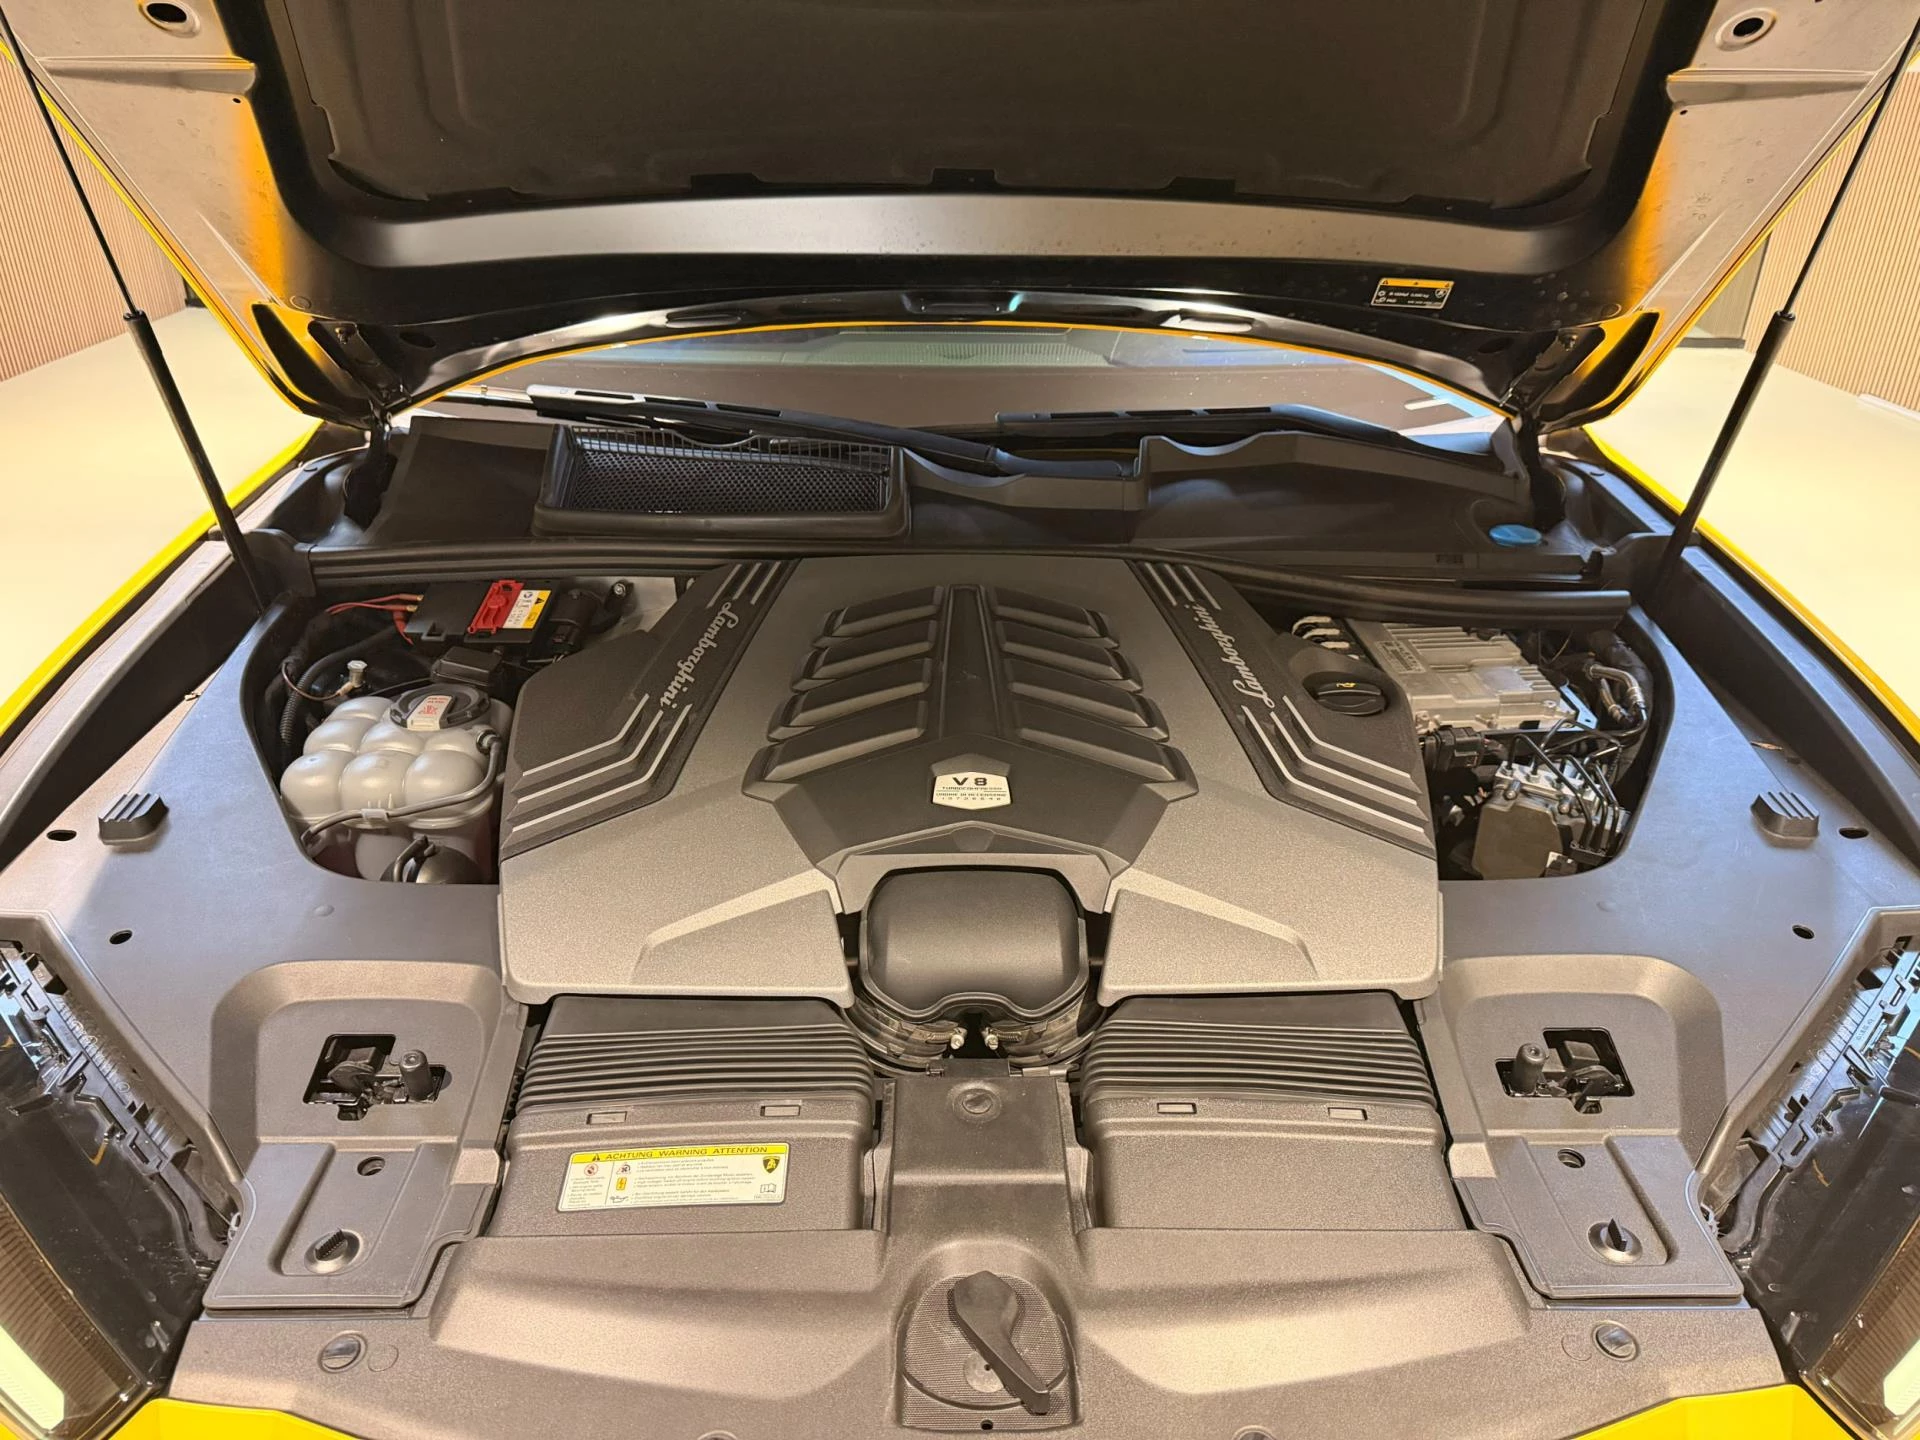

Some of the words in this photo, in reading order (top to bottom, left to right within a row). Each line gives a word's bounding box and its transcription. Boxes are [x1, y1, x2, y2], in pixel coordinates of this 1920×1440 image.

[660, 601, 739, 708] Lamborghini
[1183, 603, 1276, 709] Lamborghini
[605, 1151, 653, 1160] ACHTUNG
[659, 1148, 708, 1157] WARNING
[713, 1146, 768, 1155] ATTENTION
